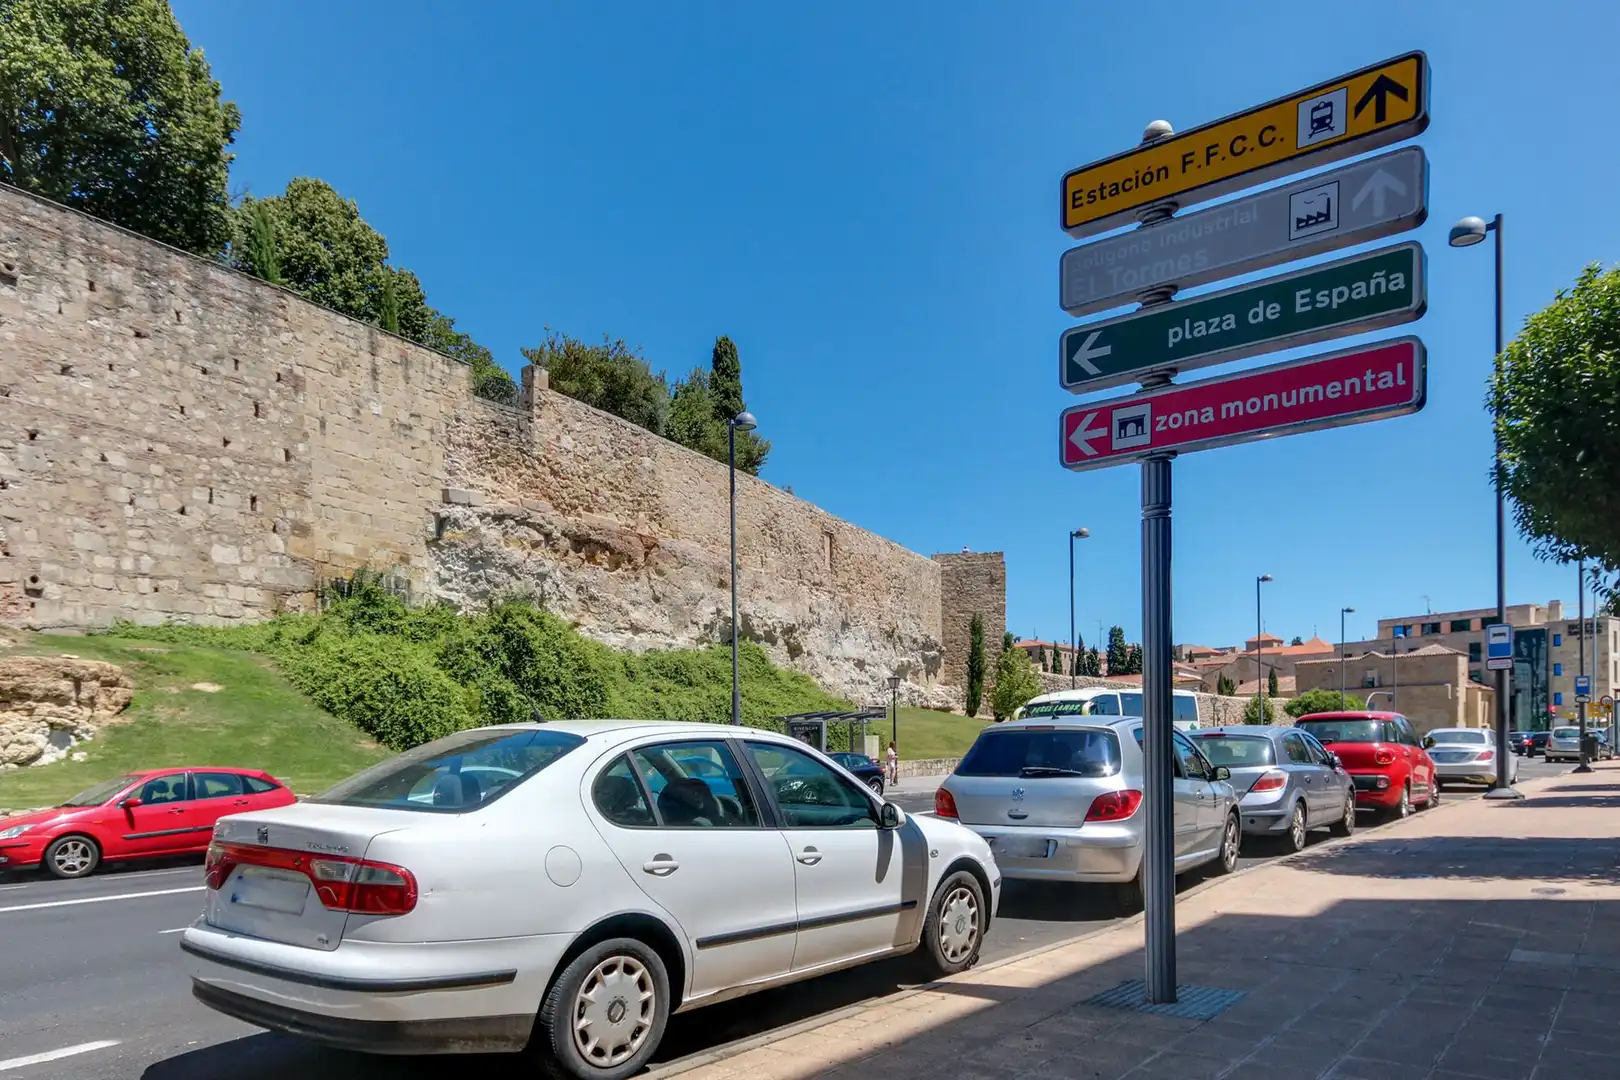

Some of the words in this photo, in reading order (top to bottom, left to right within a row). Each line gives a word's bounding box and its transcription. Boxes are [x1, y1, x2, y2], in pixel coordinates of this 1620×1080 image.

[1071, 166, 1170, 210] Estación
[1181, 125, 1285, 174] F.F.C.C.
[1109, 249, 1210, 288] Tormes
[1168, 311, 1237, 348] plaza
[1248, 299, 1282, 325] de
[1295, 269, 1406, 314] España
[1155, 406, 1216, 433] zona
[1221, 363, 1406, 419] monumental
